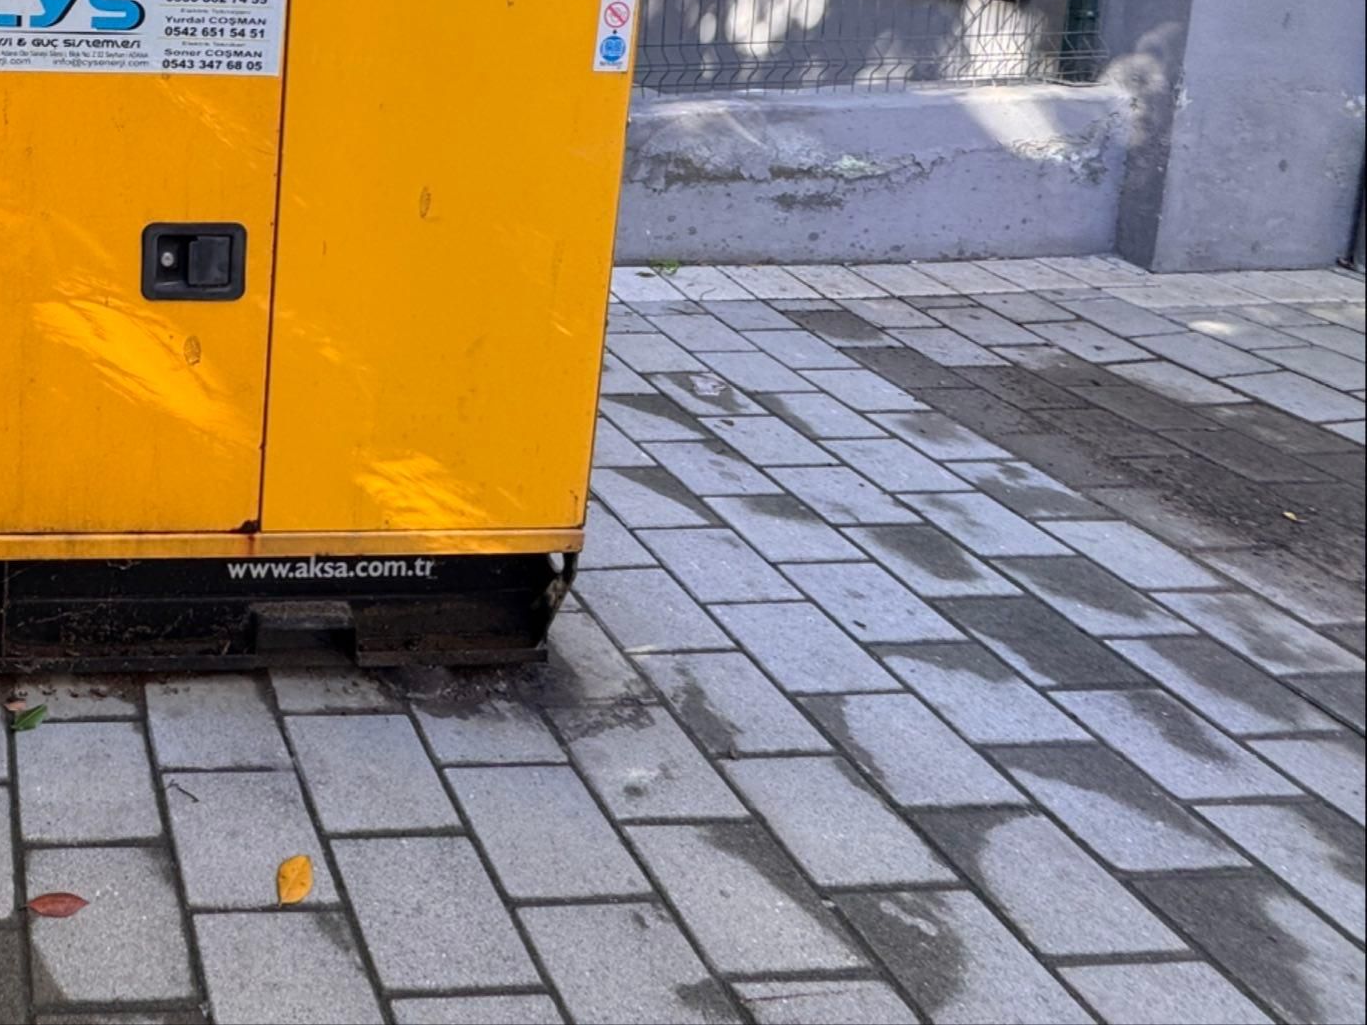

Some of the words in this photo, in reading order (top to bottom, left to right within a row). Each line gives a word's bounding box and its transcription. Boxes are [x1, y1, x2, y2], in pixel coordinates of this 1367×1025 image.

[165, 16, 205, 24] Yurdal
[208, 17, 267, 26] COŞMAN
[164, 26, 197, 36] 0542
[201, 27, 225, 37] 651
[229, 28, 246, 38] 54
[249, 28, 265, 38] 51
[17, 37, 27, 47] &
[164, 48, 202, 57] Soner
[204, 49, 263, 59] COŞMAN
[162, 59, 195, 69] 0543
[198, 59, 222, 70] 347
[226, 60, 243, 70] 68
[246, 61, 263, 71] 05
[227, 556, 434, 579] www.aksa.com.tr
